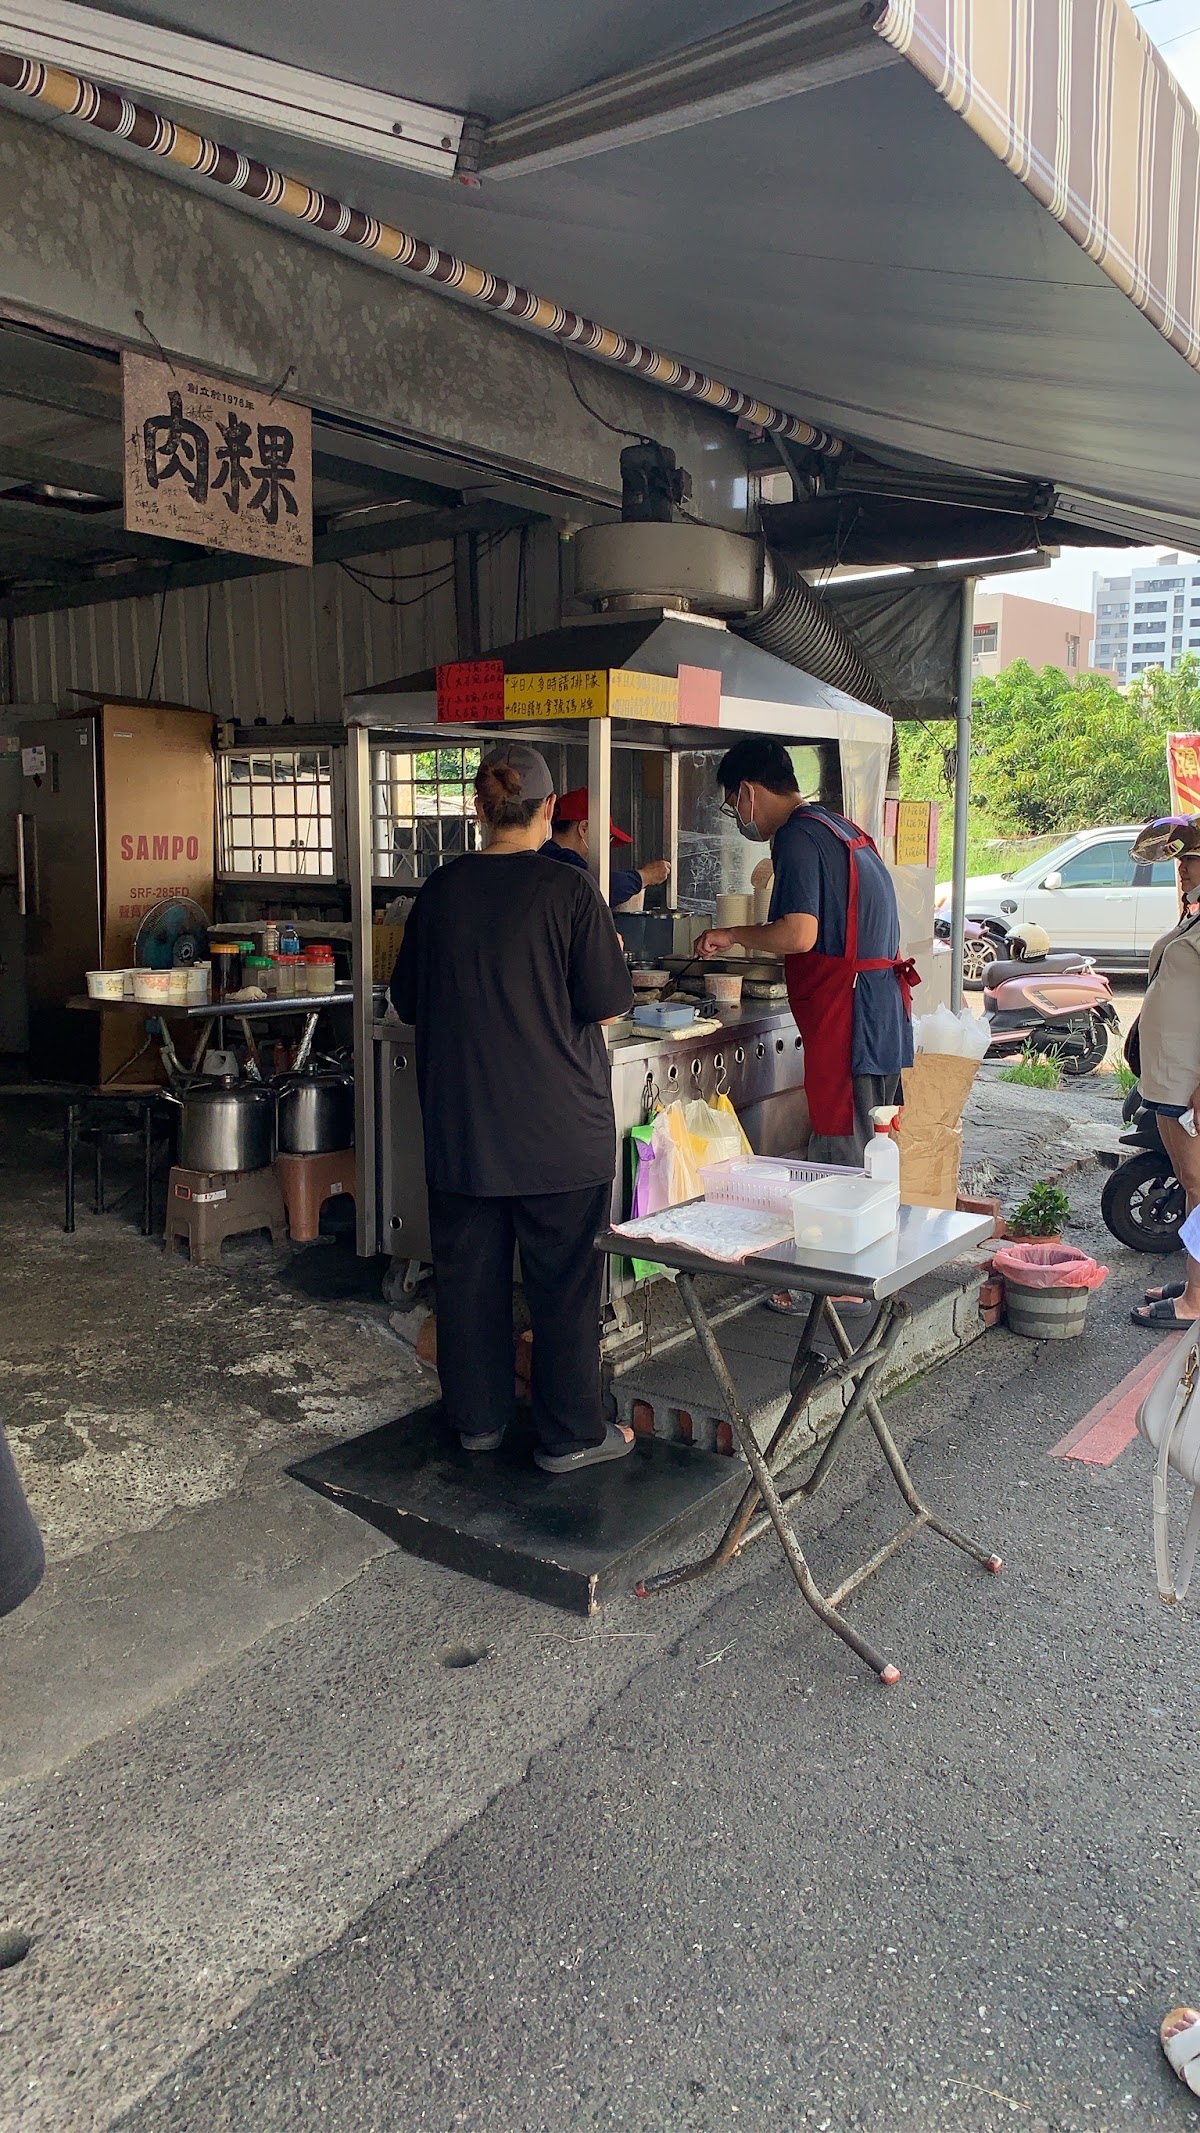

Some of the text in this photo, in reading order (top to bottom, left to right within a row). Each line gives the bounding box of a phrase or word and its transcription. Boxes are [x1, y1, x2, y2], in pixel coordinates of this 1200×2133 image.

[187, 382, 255, 411] 創立於1976年
[143, 390, 299, 525] 肉粿
[121, 834, 199, 861] SAMPO
